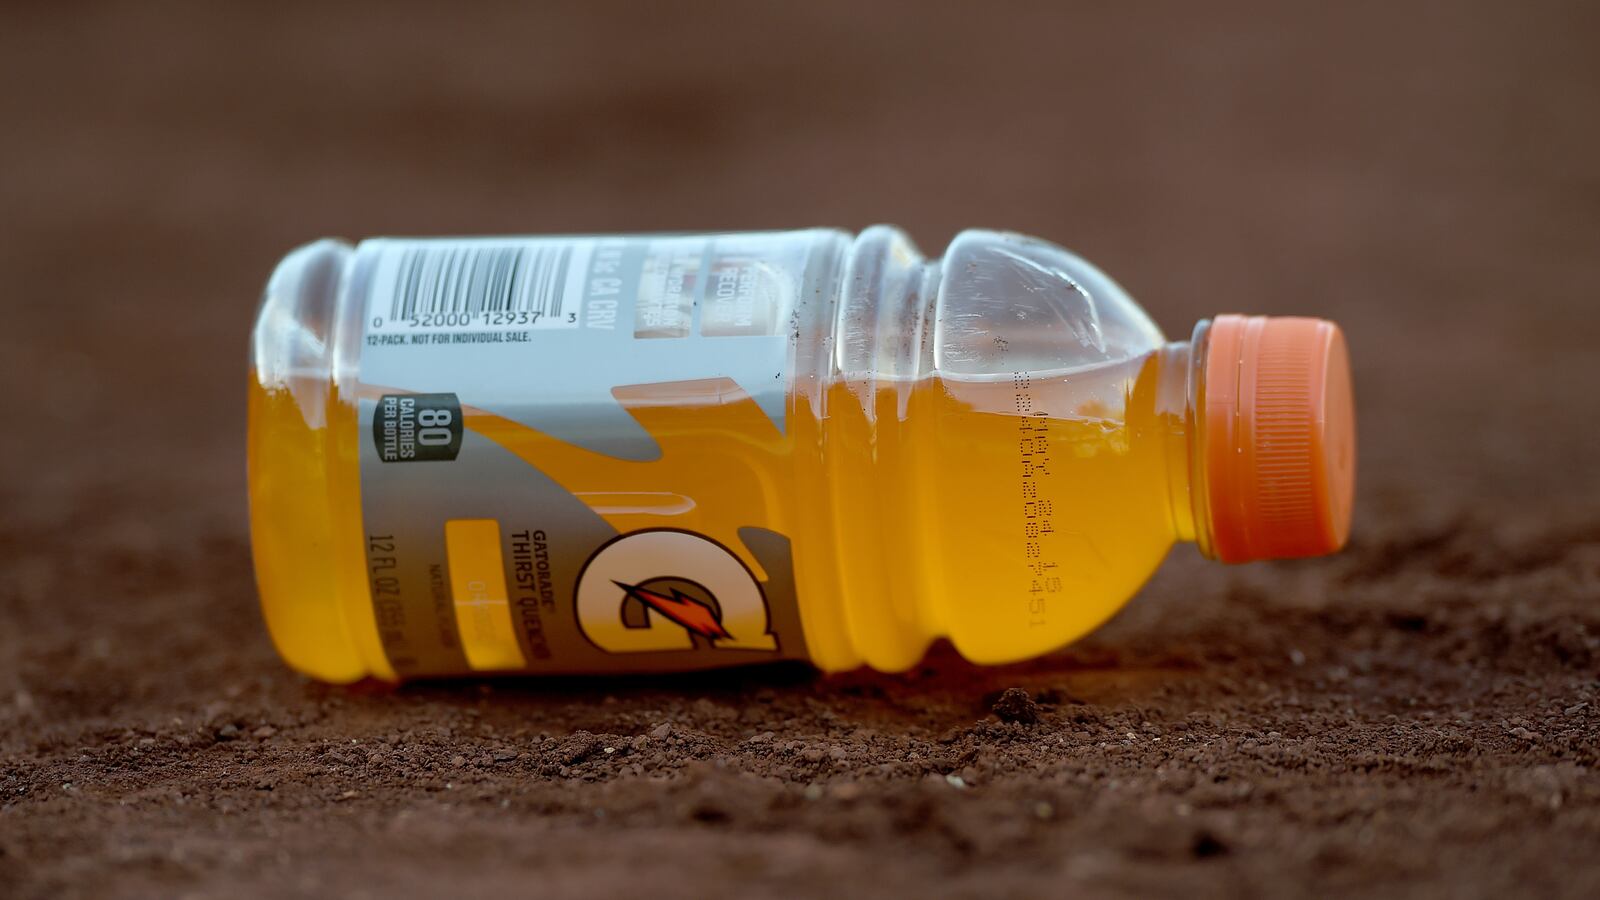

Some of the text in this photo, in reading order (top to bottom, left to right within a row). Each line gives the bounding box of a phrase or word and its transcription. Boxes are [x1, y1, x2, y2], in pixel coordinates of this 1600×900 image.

[590, 278, 622, 296] CA
[715, 266, 738, 323] RECOVER
[372, 311, 577, 329] 0 52000 12937 3
[586, 300, 619, 330] CRV
[367, 331, 532, 346] 12-PACK. NOT FOR INDIVIDUAL SALE.
[383, 397, 398, 461] PER BOTTLE
[400, 398, 415, 459] CALORIES
[418, 409, 452, 446] 80
[1033, 412, 1050, 476] MAY
[369, 534, 395, 552] 12
[511, 530, 537, 592] THIRST
[372, 557, 397, 573] FL
[533, 529, 556, 608] GATORADE
[374, 577, 400, 596] OZ
[573, 526, 783, 655] G
